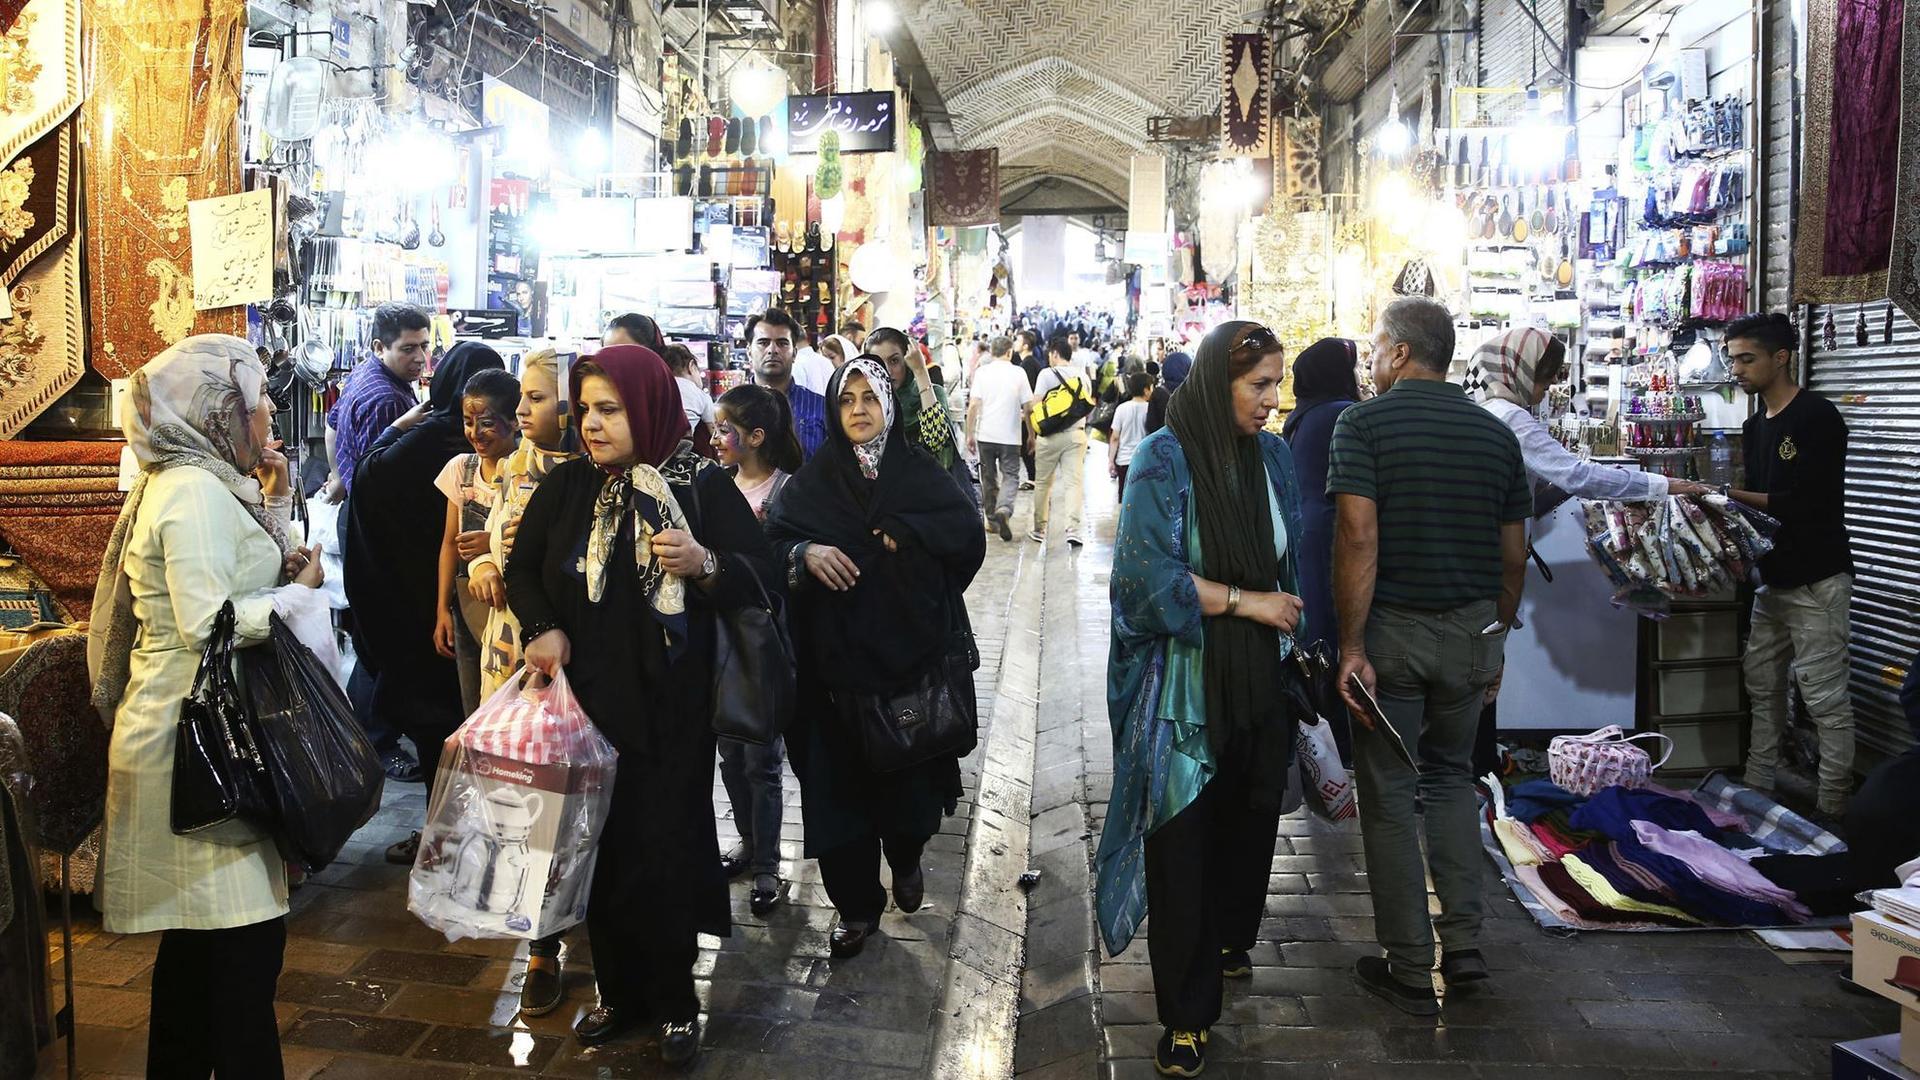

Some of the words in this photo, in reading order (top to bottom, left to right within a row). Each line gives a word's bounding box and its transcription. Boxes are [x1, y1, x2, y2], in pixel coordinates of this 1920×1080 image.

[793, 102, 809, 127] یزد
[856, 102, 889, 132] ترمه
[492, 766, 533, 784] Homeking
